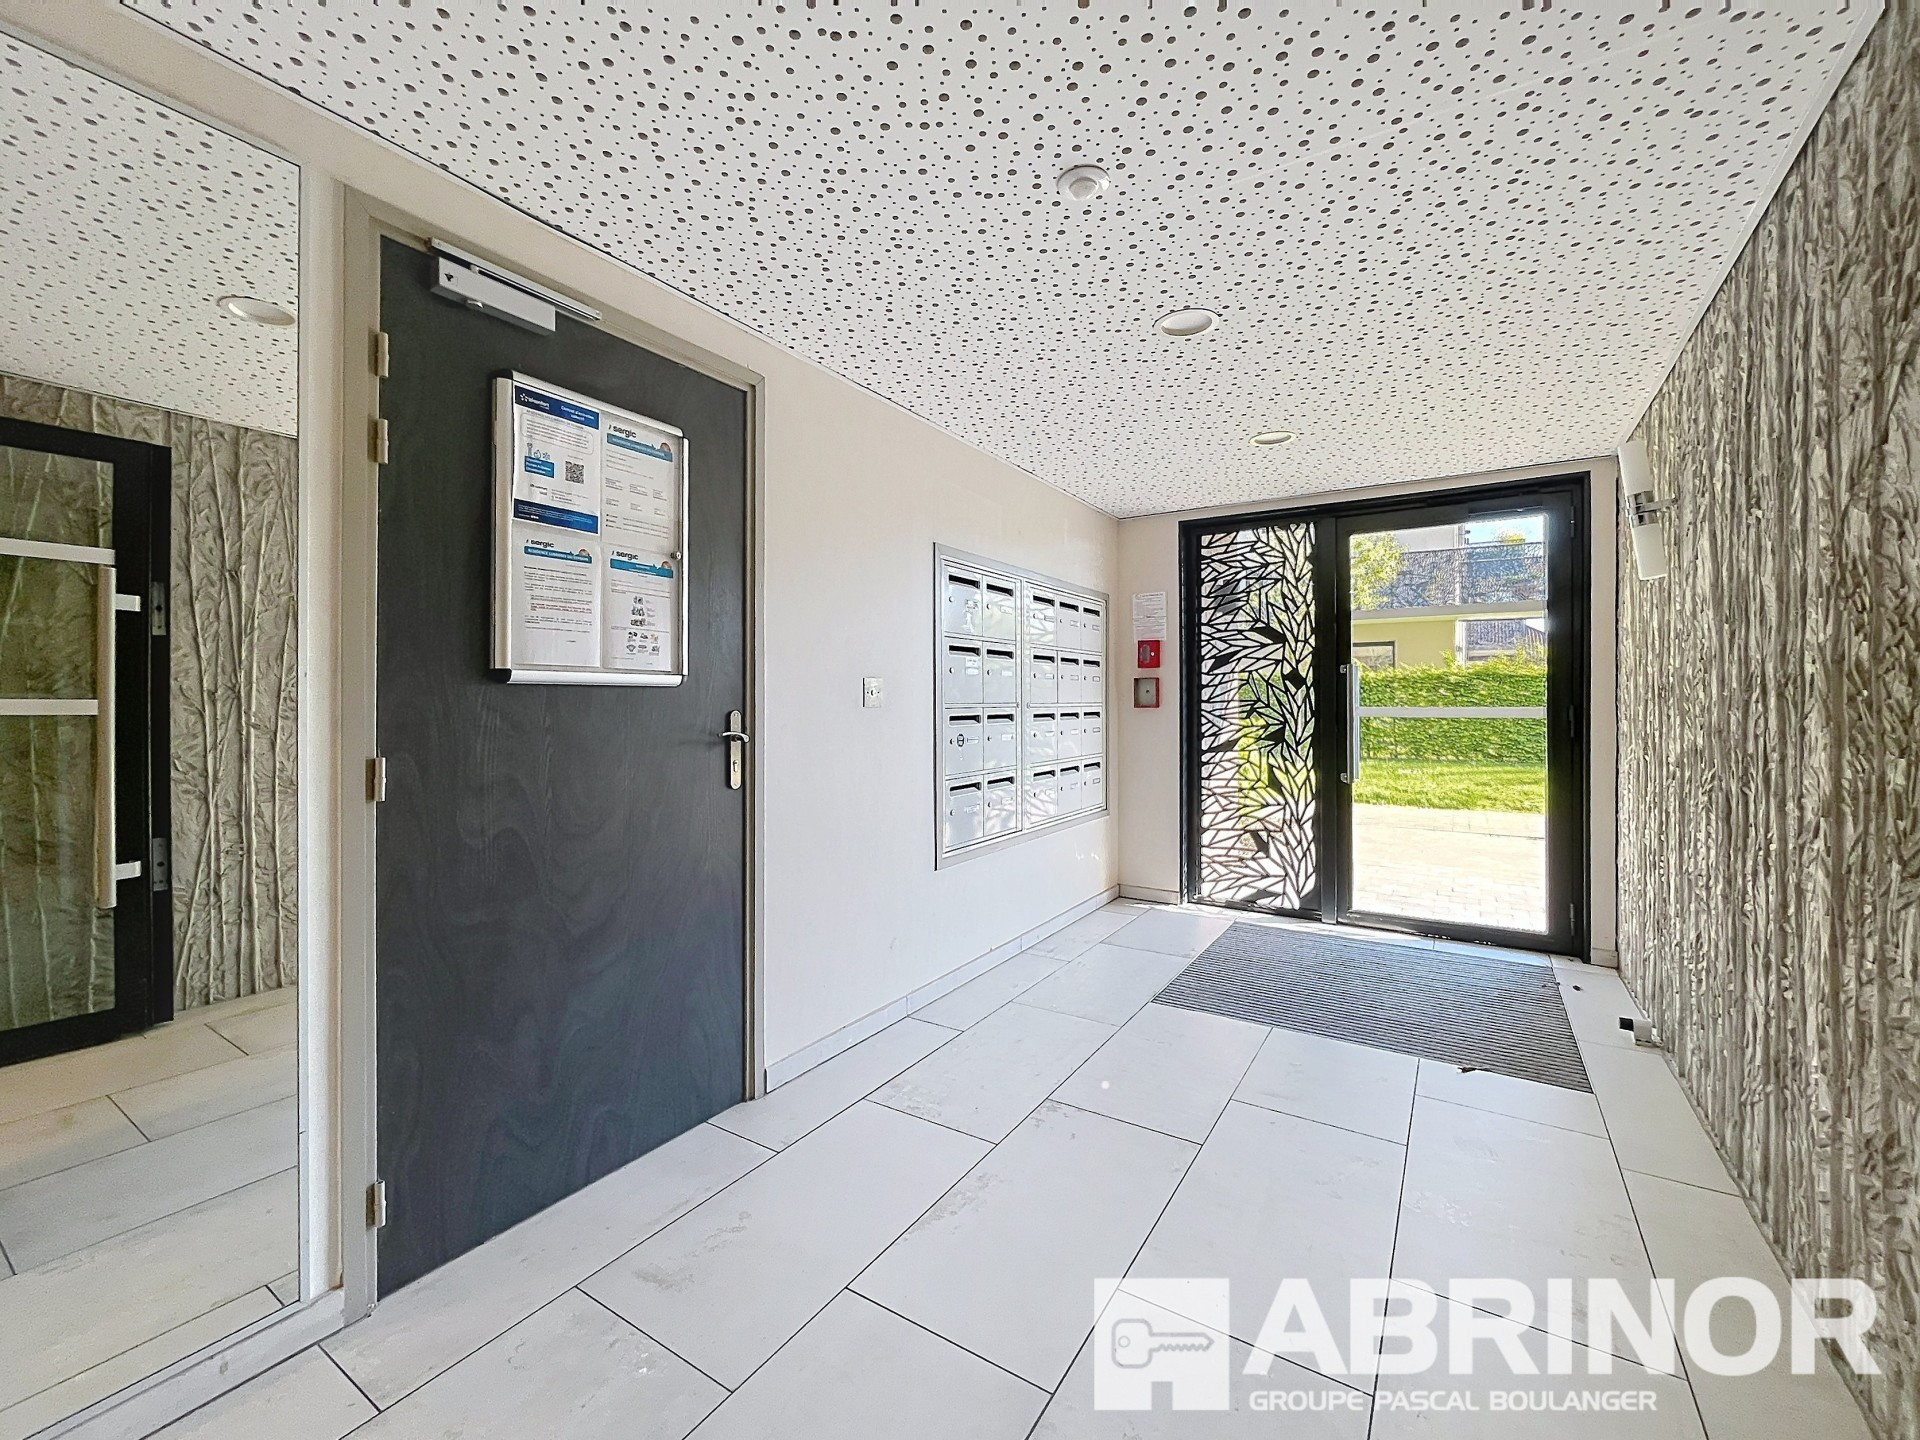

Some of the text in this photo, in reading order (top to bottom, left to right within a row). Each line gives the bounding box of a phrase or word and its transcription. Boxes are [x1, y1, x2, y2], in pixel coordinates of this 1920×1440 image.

[613, 425, 637, 439] sergic
[530, 539, 555, 549] sergic
[616, 551, 639, 561] sergic
